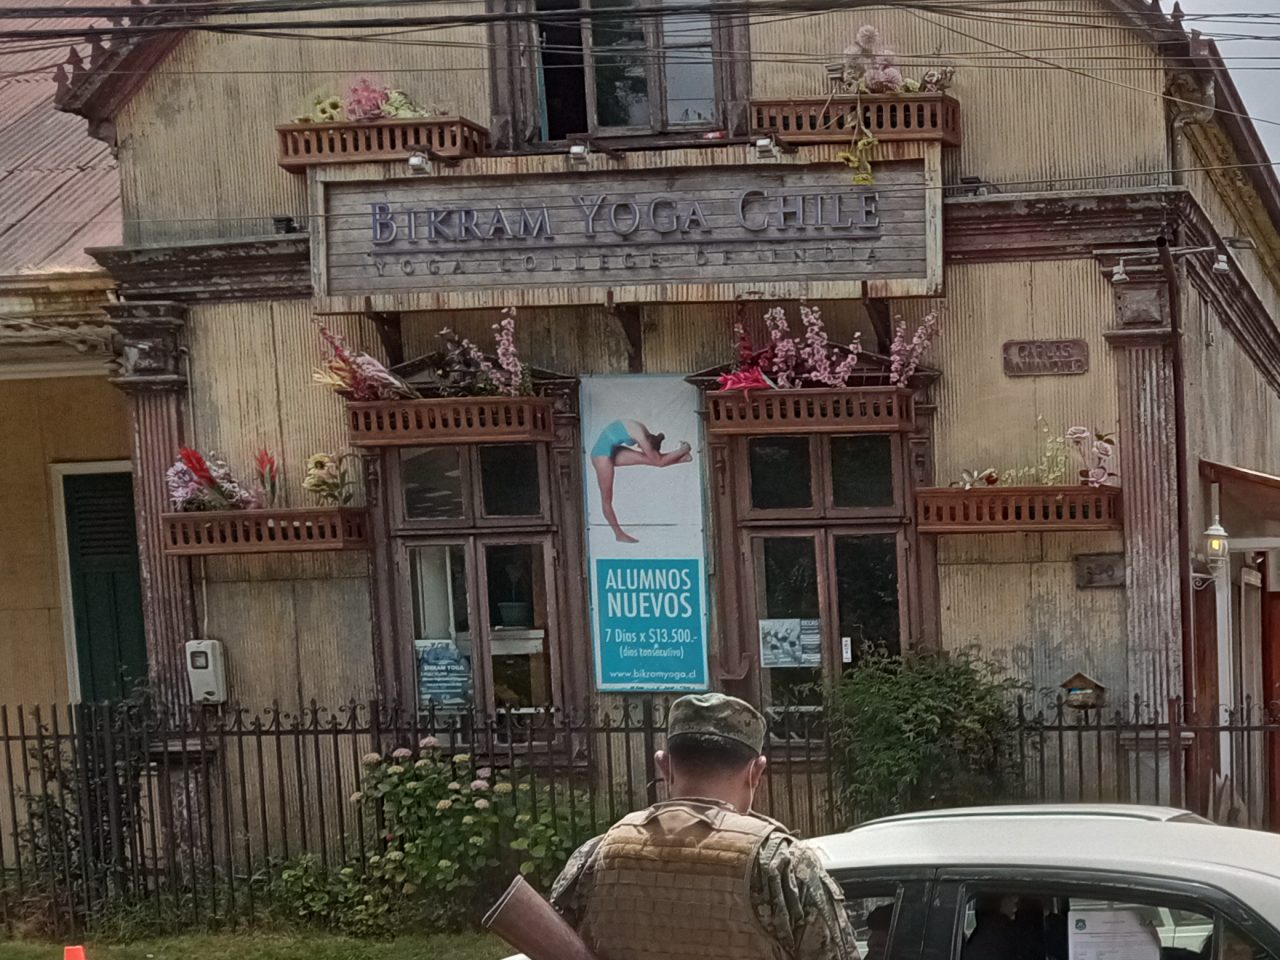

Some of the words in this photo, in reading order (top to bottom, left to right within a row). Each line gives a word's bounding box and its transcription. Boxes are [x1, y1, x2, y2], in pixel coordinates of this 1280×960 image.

[371, 202, 554, 246] BIKRAM
[572, 194, 711, 239] YOGA
[737, 190, 880, 231] CHILE
[375, 259, 466, 277] YOGA
[500, 252, 659, 273] COLLEGE
[695, 249, 731, 266] OF
[606, 568, 692, 590] ALUMNOS
[607, 592, 692, 618] NUEVOS
[605, 628, 612, 643] 7
[640, 632, 646, 642] x
